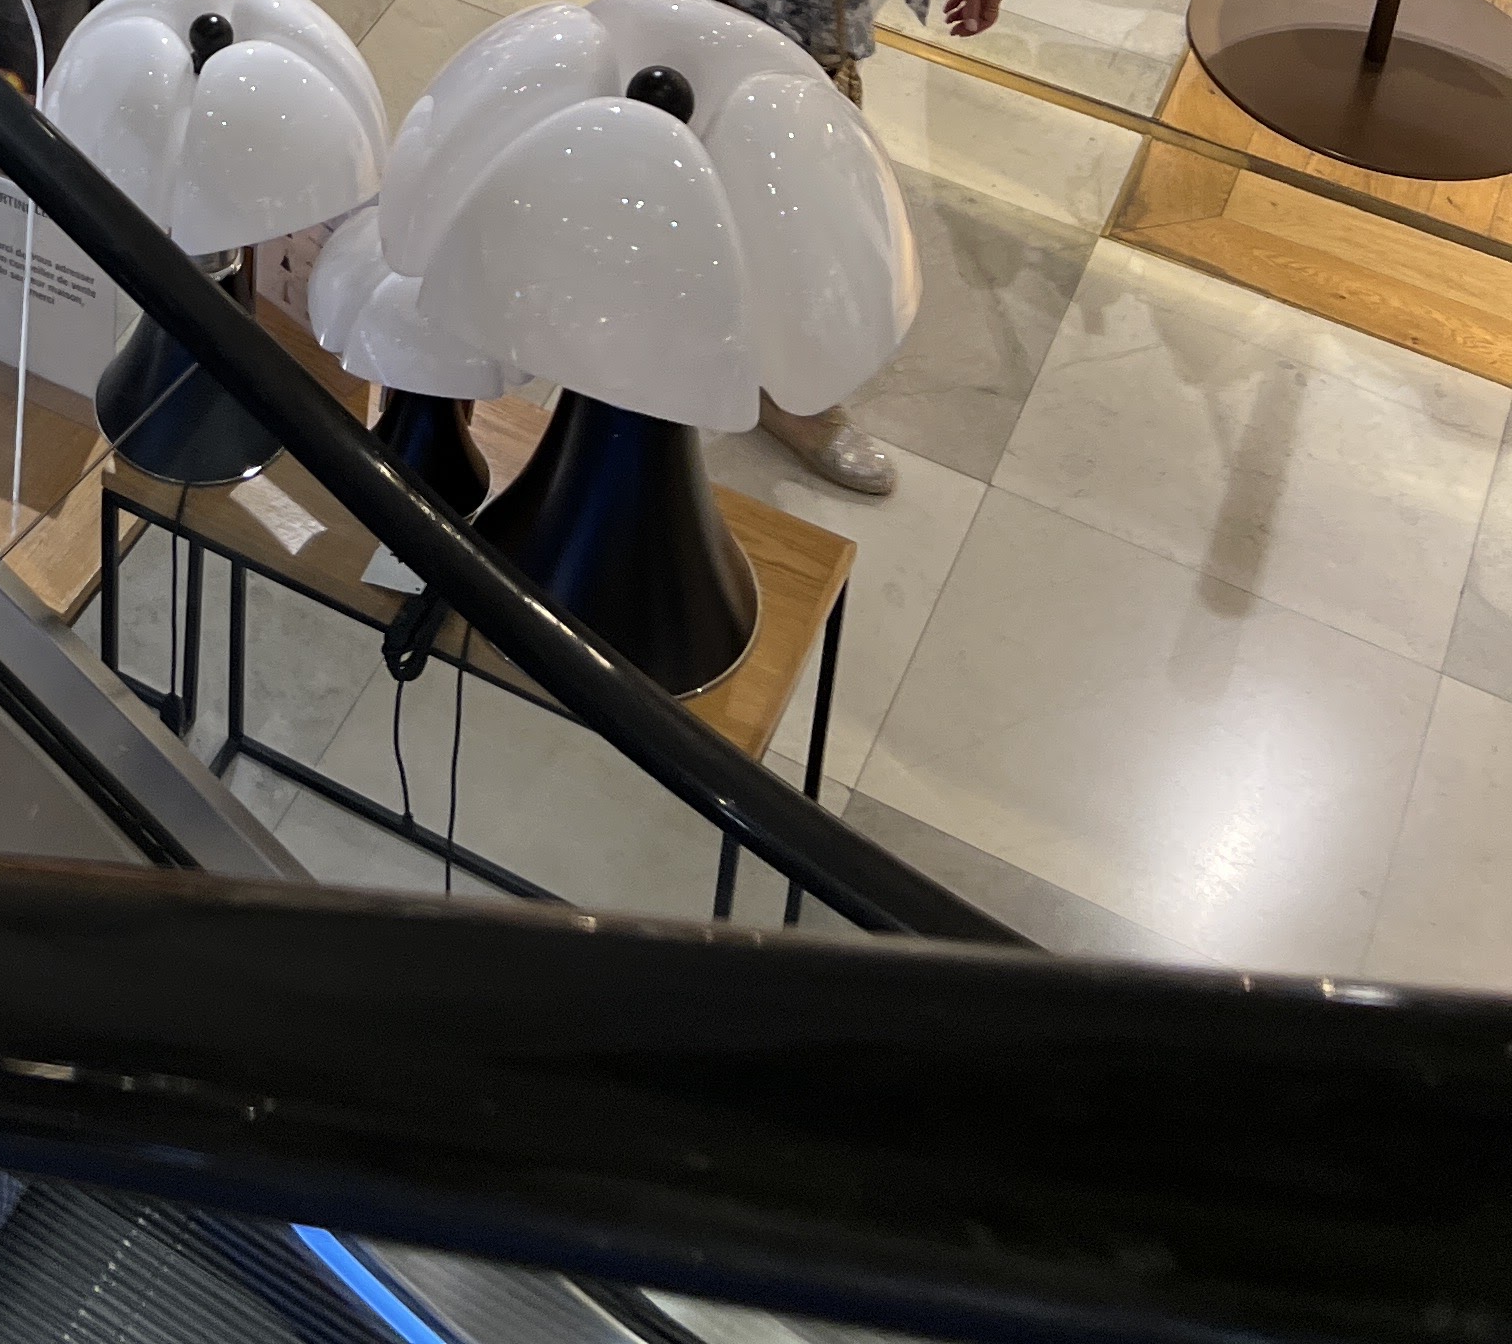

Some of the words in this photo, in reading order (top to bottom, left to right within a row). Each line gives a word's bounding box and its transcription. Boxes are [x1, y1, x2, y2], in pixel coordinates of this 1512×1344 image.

[55, 263, 94, 284] adresser
[29, 288, 55, 305] merci
[57, 276, 68, 286] de
[71, 282, 96, 298] vente
